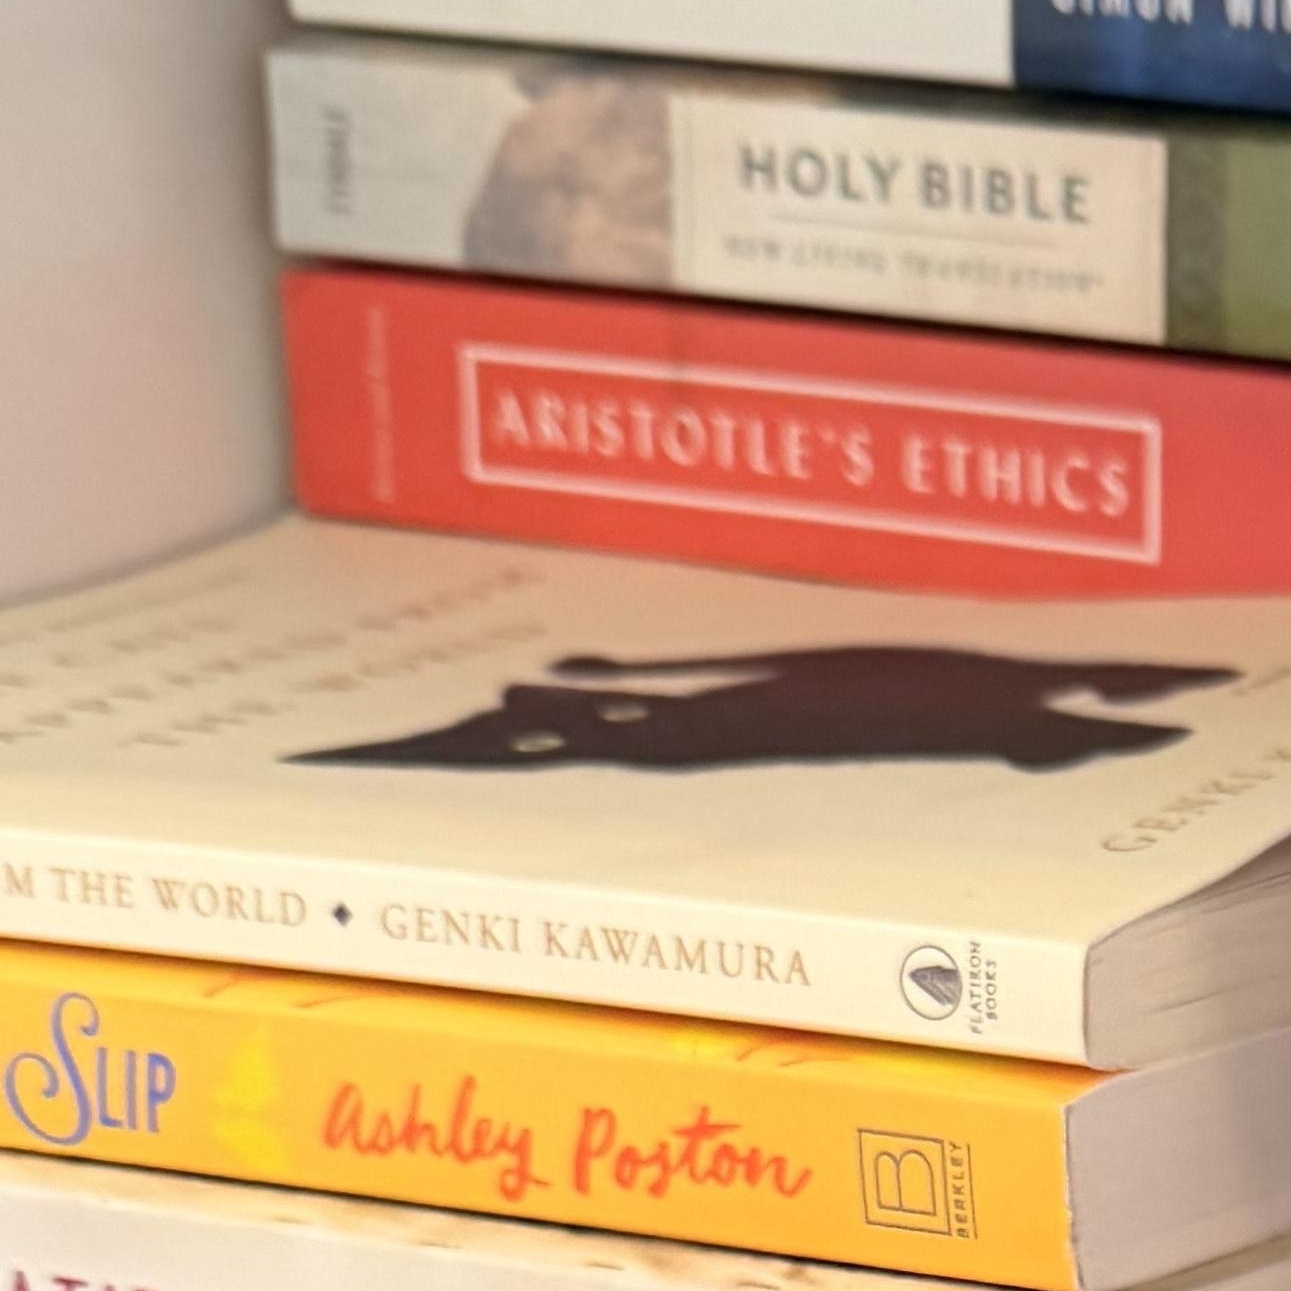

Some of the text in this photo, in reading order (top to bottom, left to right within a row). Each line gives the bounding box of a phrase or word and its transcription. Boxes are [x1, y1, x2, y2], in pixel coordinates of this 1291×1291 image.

[736, 141, 1091, 226] HOLY BIBLE
[494, 383, 872, 489] ARISTOTLE'S
[902, 434, 1131, 520] ETHICS
[54, 868, 134, 910] THE
[151, 878, 308, 929] WORLD
[380, 903, 522, 954] GENKI
[543, 922, 813, 989] KAWAMURA
[968, 939, 984, 1035] FLATIRON
[985, 960, 999, 1021] BOOKS
[573, 1104, 813, 1201] Poston
[948, 1140, 971, 1239] BERKLEY
